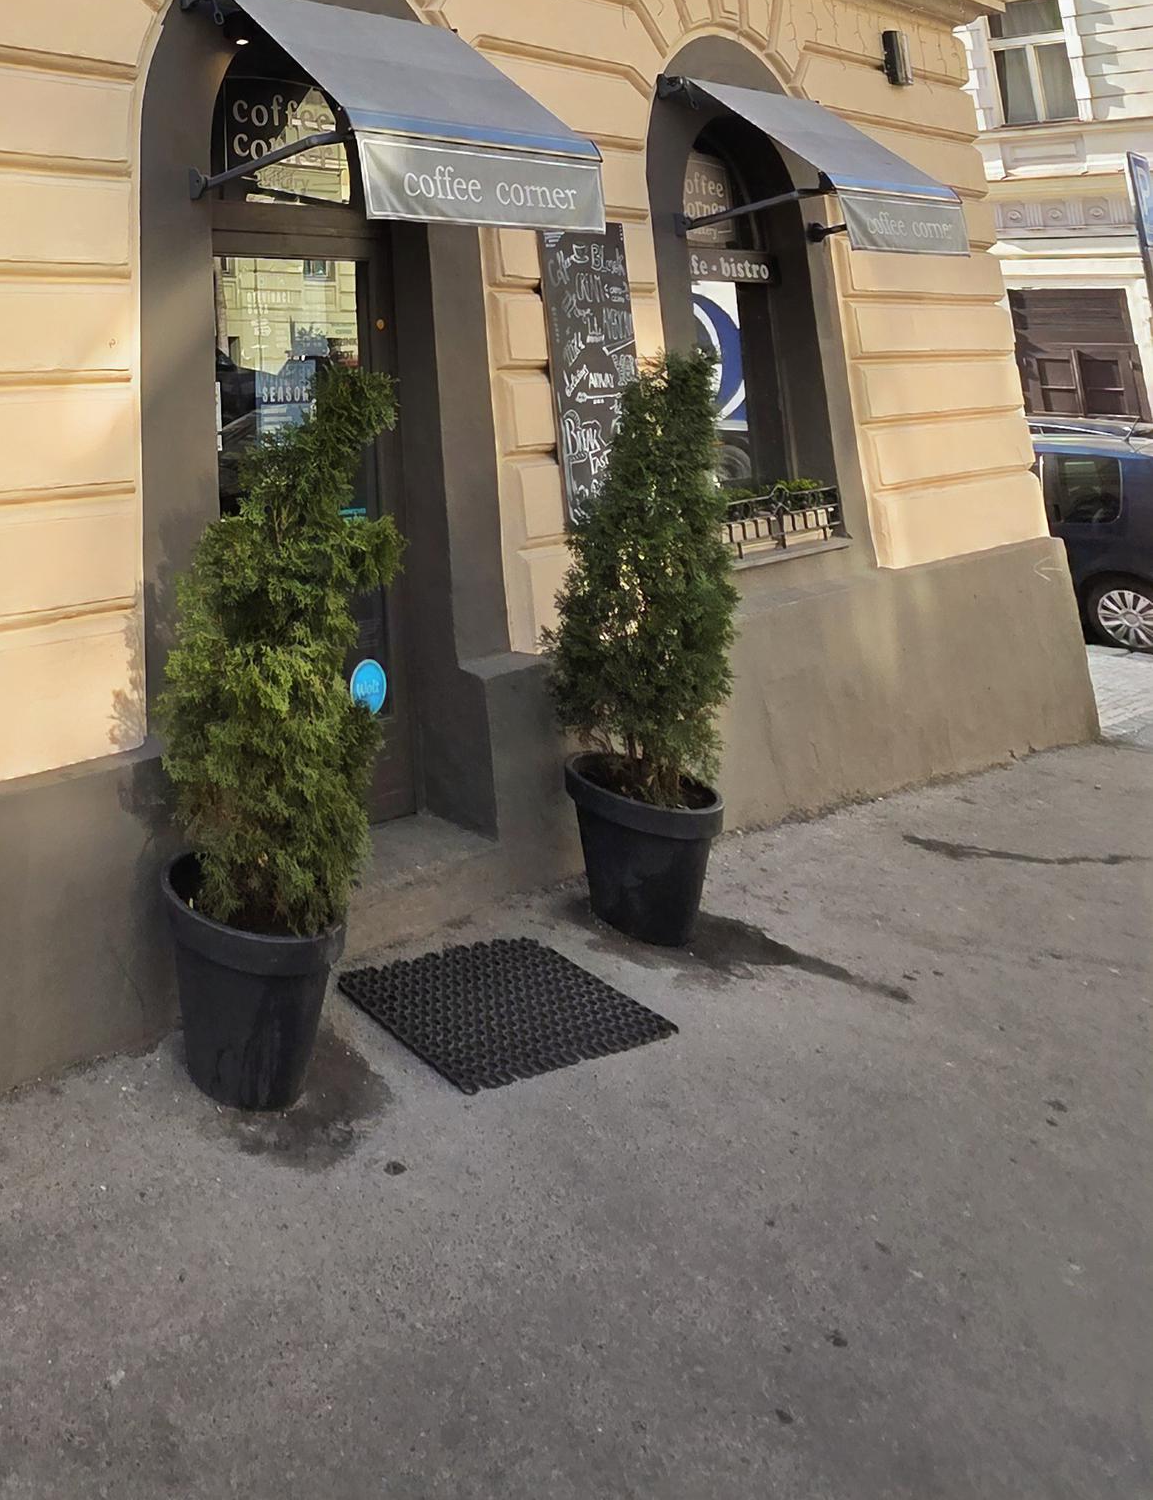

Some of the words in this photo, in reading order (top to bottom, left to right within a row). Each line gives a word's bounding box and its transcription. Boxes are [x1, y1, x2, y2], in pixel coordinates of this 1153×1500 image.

[232, 94, 331, 132] coffee
[233, 133, 333, 169] corer
[403, 165, 483, 203] coffee
[496, 182, 577, 210] corner
[686, 171, 725, 198] offee
[867, 211, 907, 237] coffee
[691, 254, 708, 275] fe
[719, 256, 769, 279] bistro
[356, 678, 380, 699] Wolt
